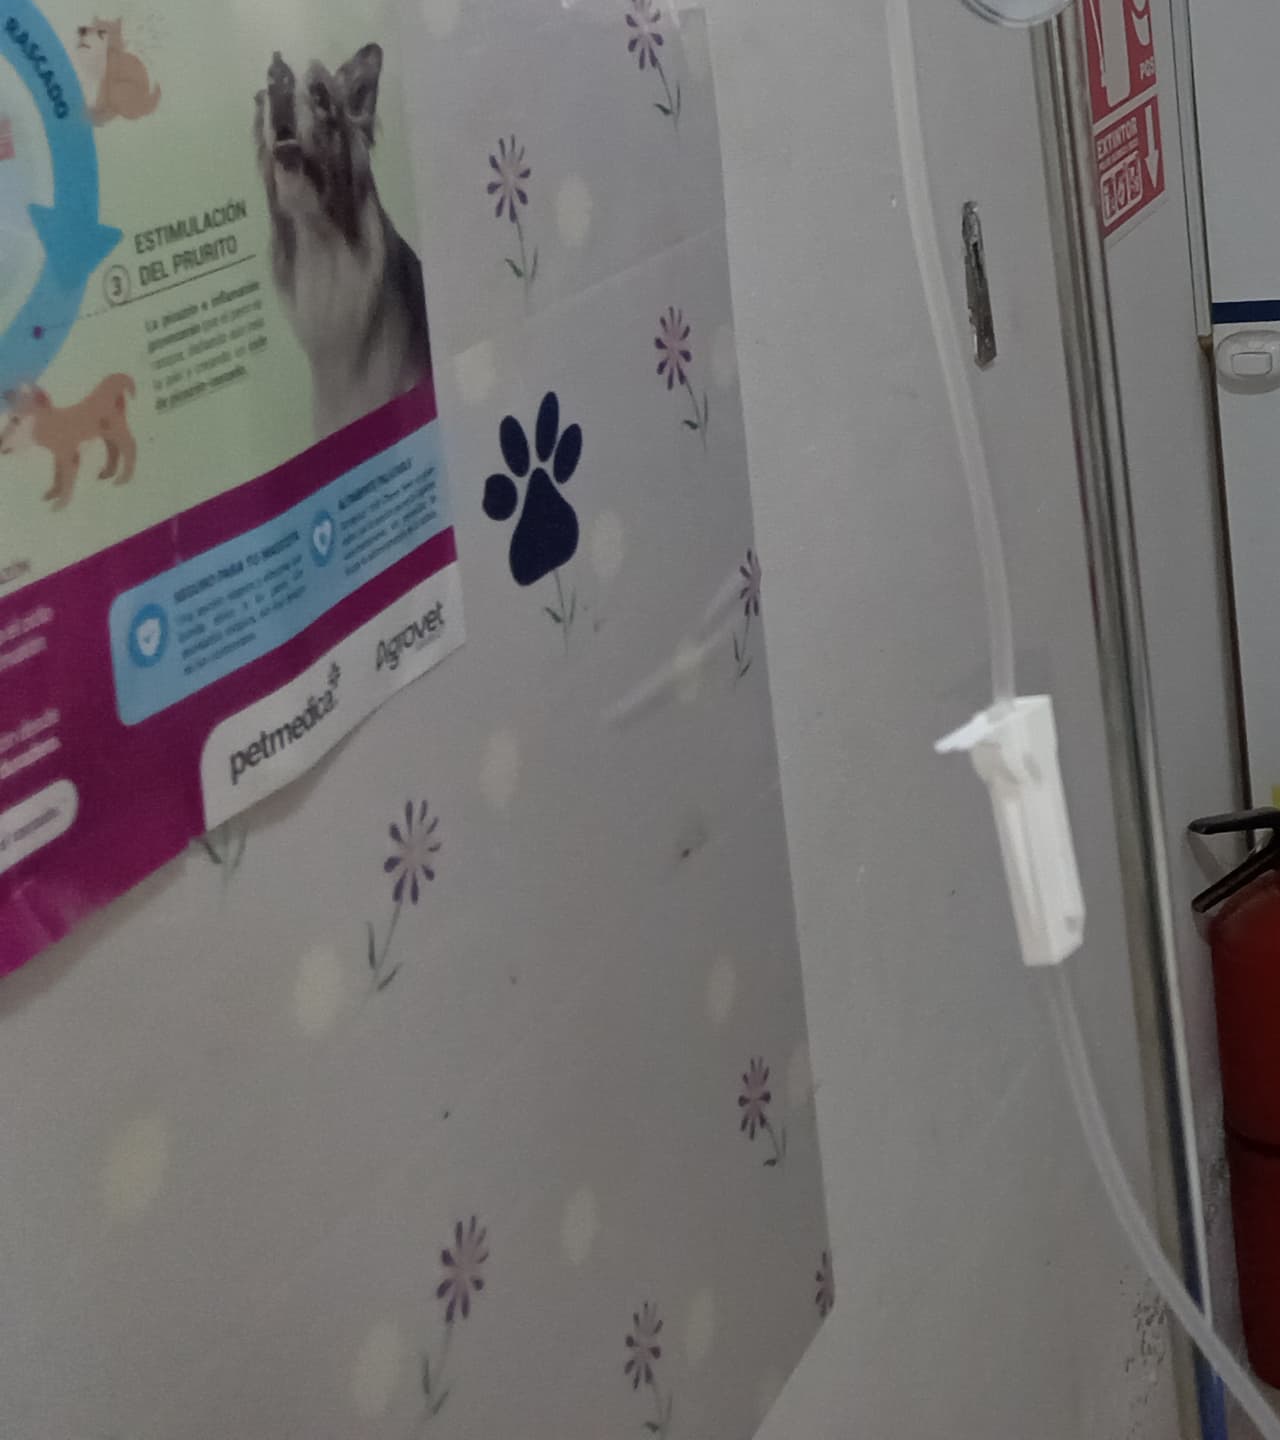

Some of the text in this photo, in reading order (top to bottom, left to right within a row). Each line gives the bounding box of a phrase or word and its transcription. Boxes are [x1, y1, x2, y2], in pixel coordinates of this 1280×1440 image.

[134, 198, 247, 254] ESTIMULACIÓN
[139, 260, 169, 286] DEL
[375, 600, 445, 672] Agrovet
[229, 689, 335, 785] petmedica
